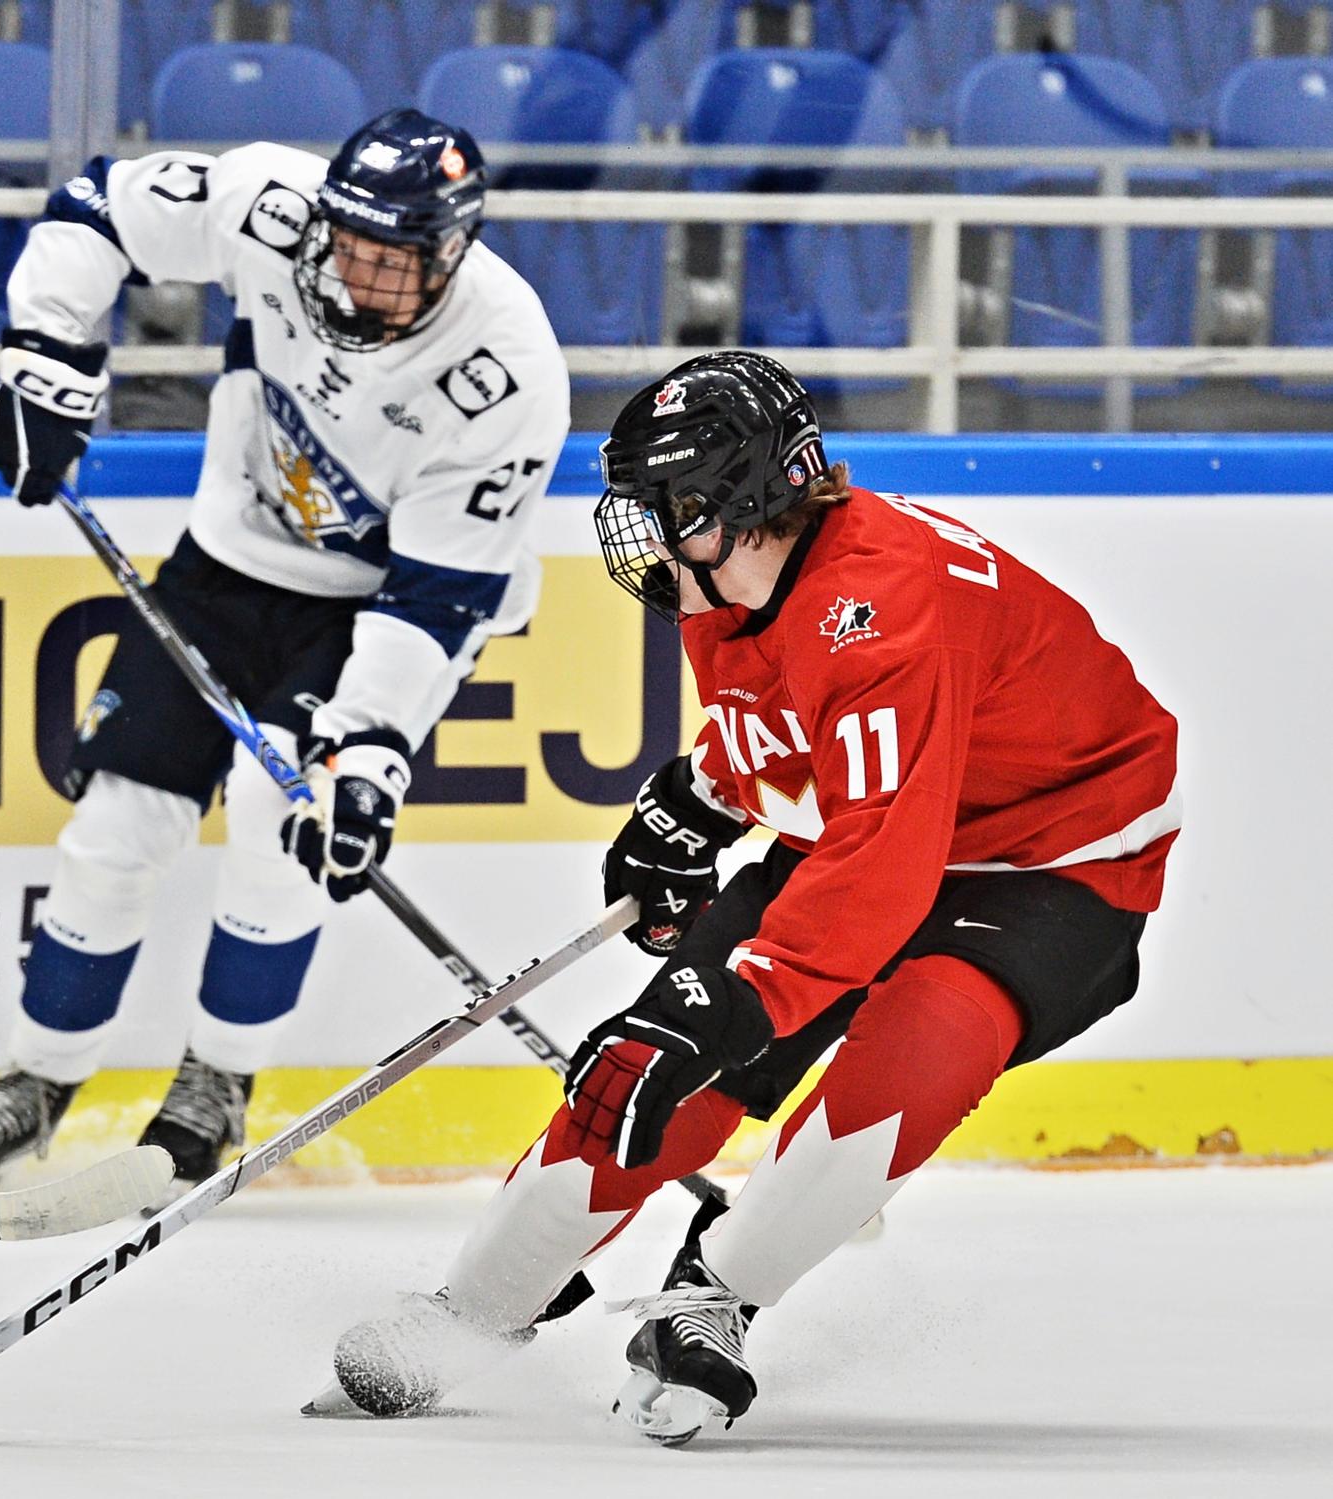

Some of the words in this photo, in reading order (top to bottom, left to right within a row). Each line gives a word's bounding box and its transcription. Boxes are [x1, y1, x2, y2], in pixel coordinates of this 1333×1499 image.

[647, 448, 696, 467] BAUER
[800, 443, 824, 477] 11
[679, 514, 708, 539] BAUE
[830, 630, 882, 654] CANADA
[835, 707, 900, 801] 11
[635, 773, 709, 857] UER
[261, 1076, 383, 1174] RIBCOR
[23, 1220, 163, 1336] CCM
